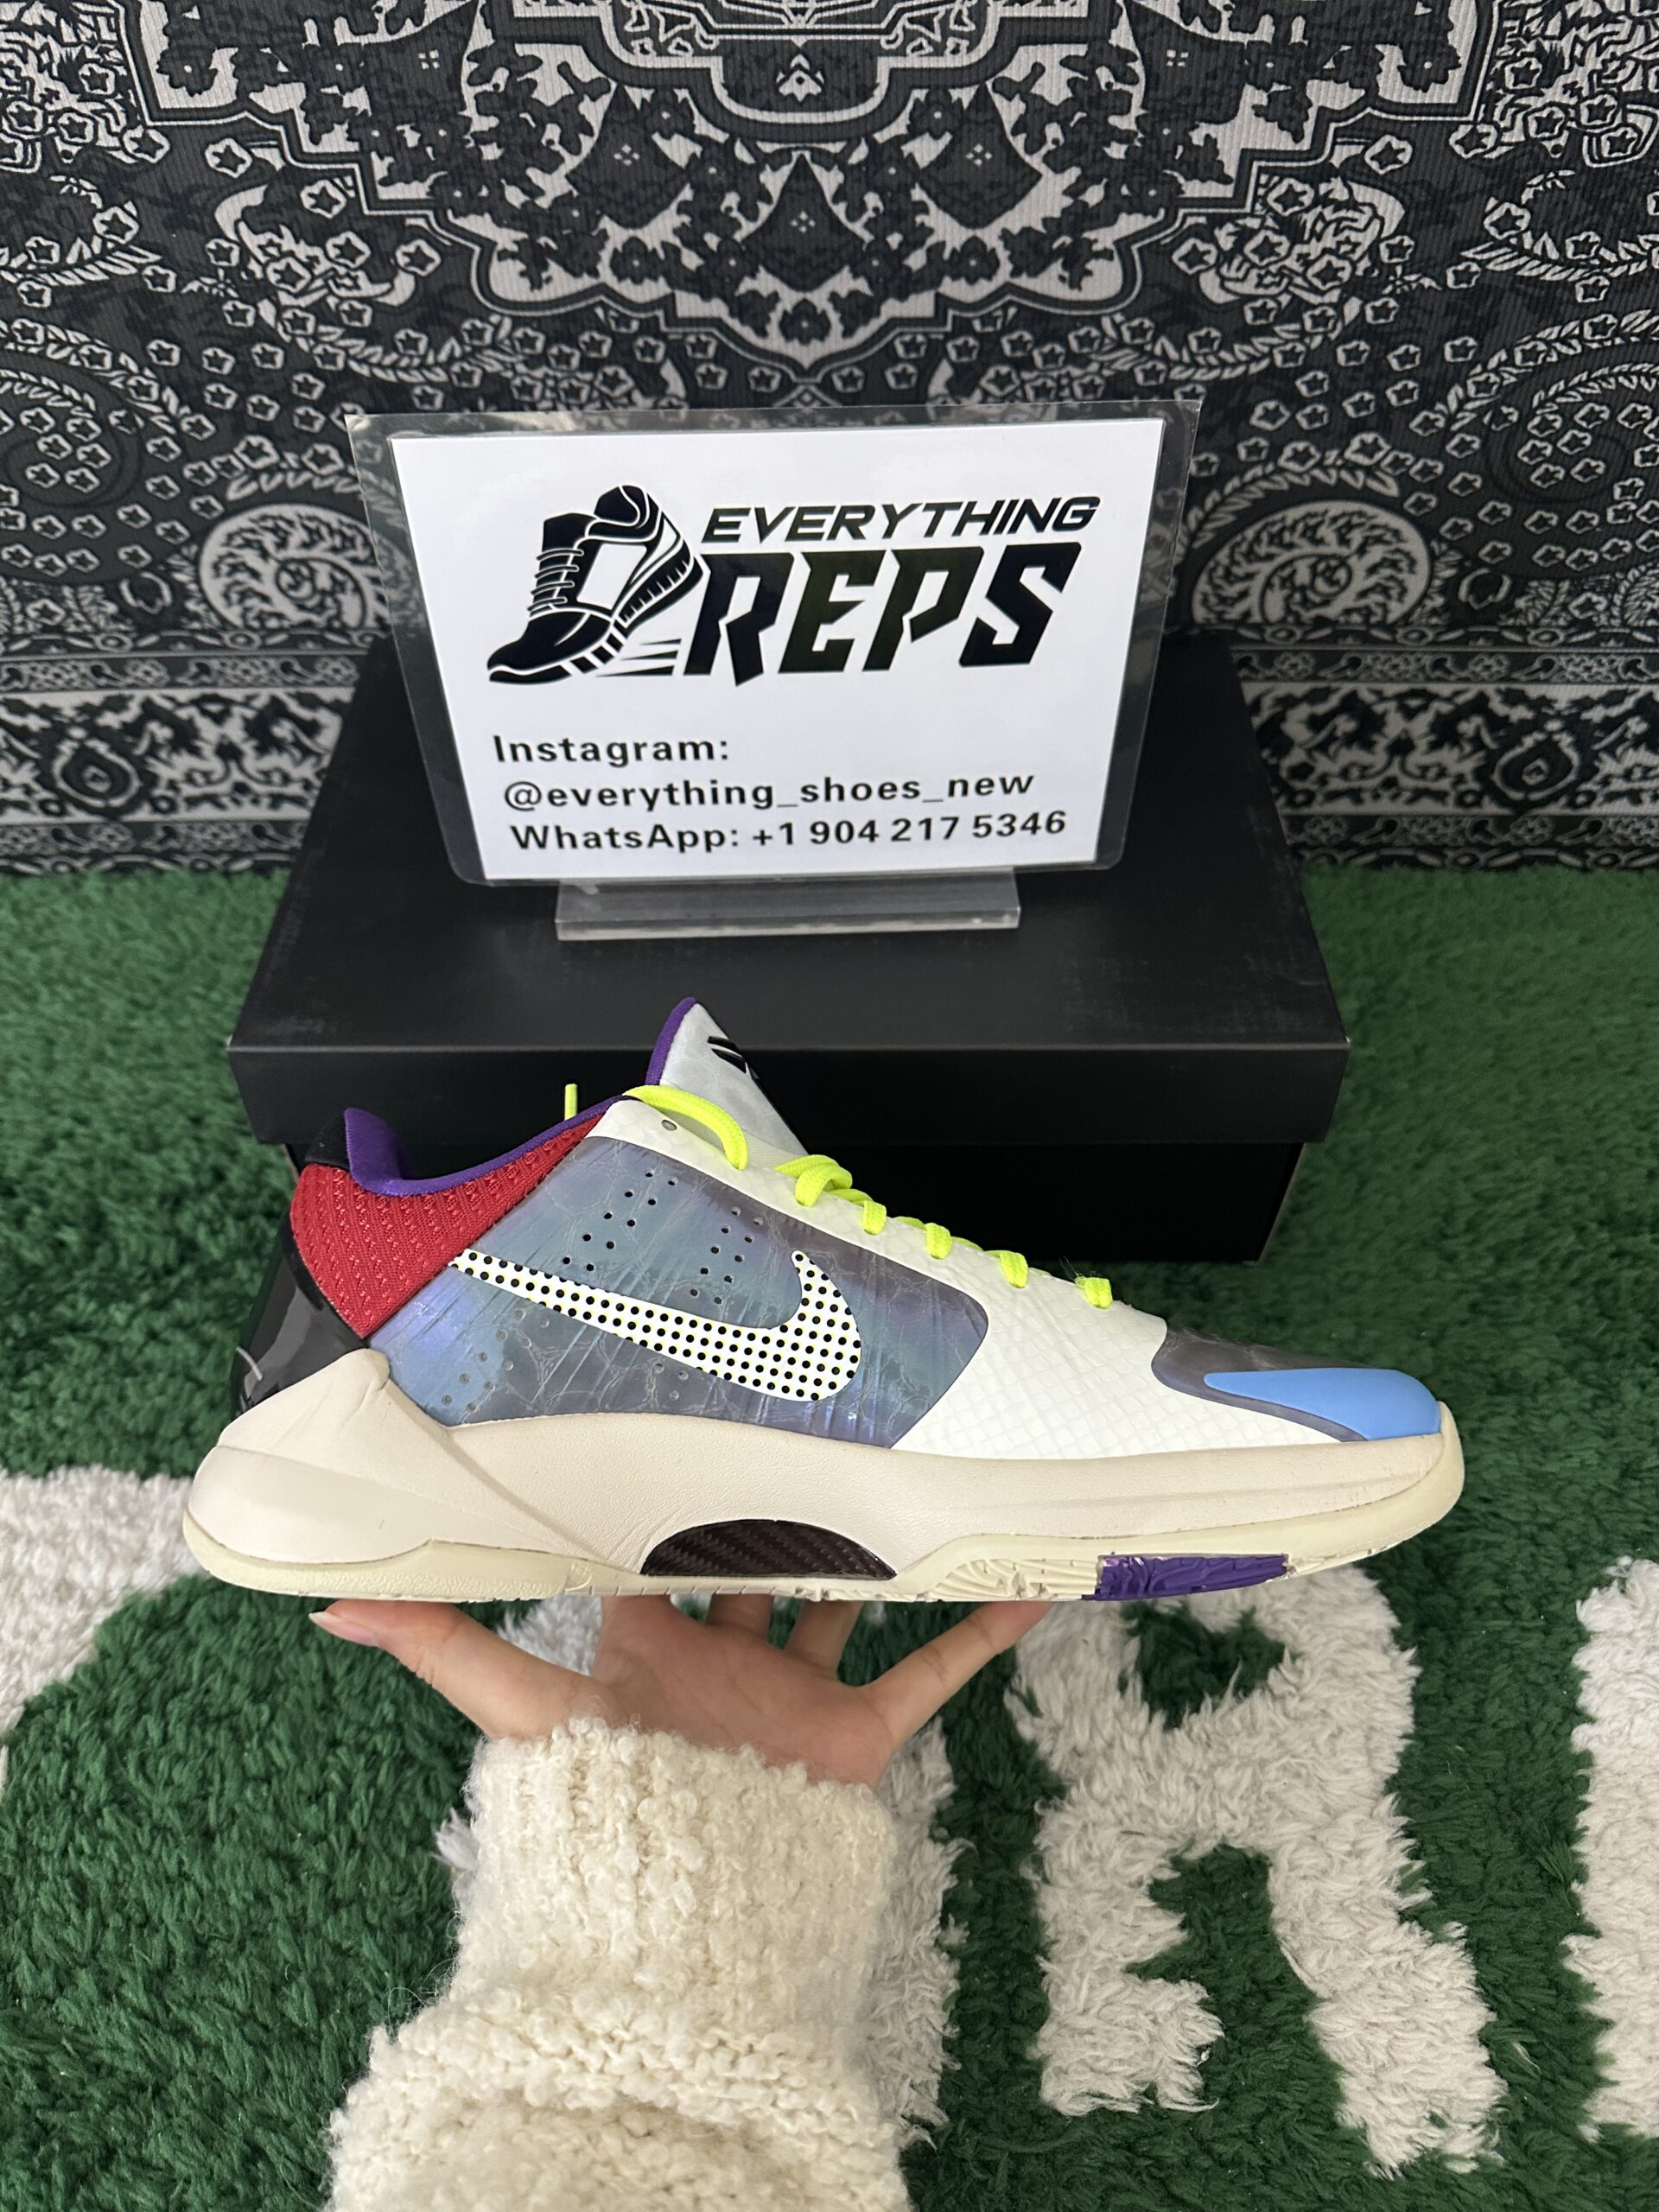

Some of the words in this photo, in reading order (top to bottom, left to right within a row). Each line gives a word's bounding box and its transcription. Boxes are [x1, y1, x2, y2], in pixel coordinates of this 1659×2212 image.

[701, 496, 1101, 543] EVERYTHING
[683, 541, 1082, 687] REPS
[493, 734, 728, 768] Instagram:
[504, 775, 1034, 812] @everything_shoes_new
[510, 823, 739, 854] WhatsApp:
[752, 821, 794, 846] +1
[810, 817, 880, 845] 904
[891, 815, 959, 842] 217
[972, 810, 1065, 839] 5346
